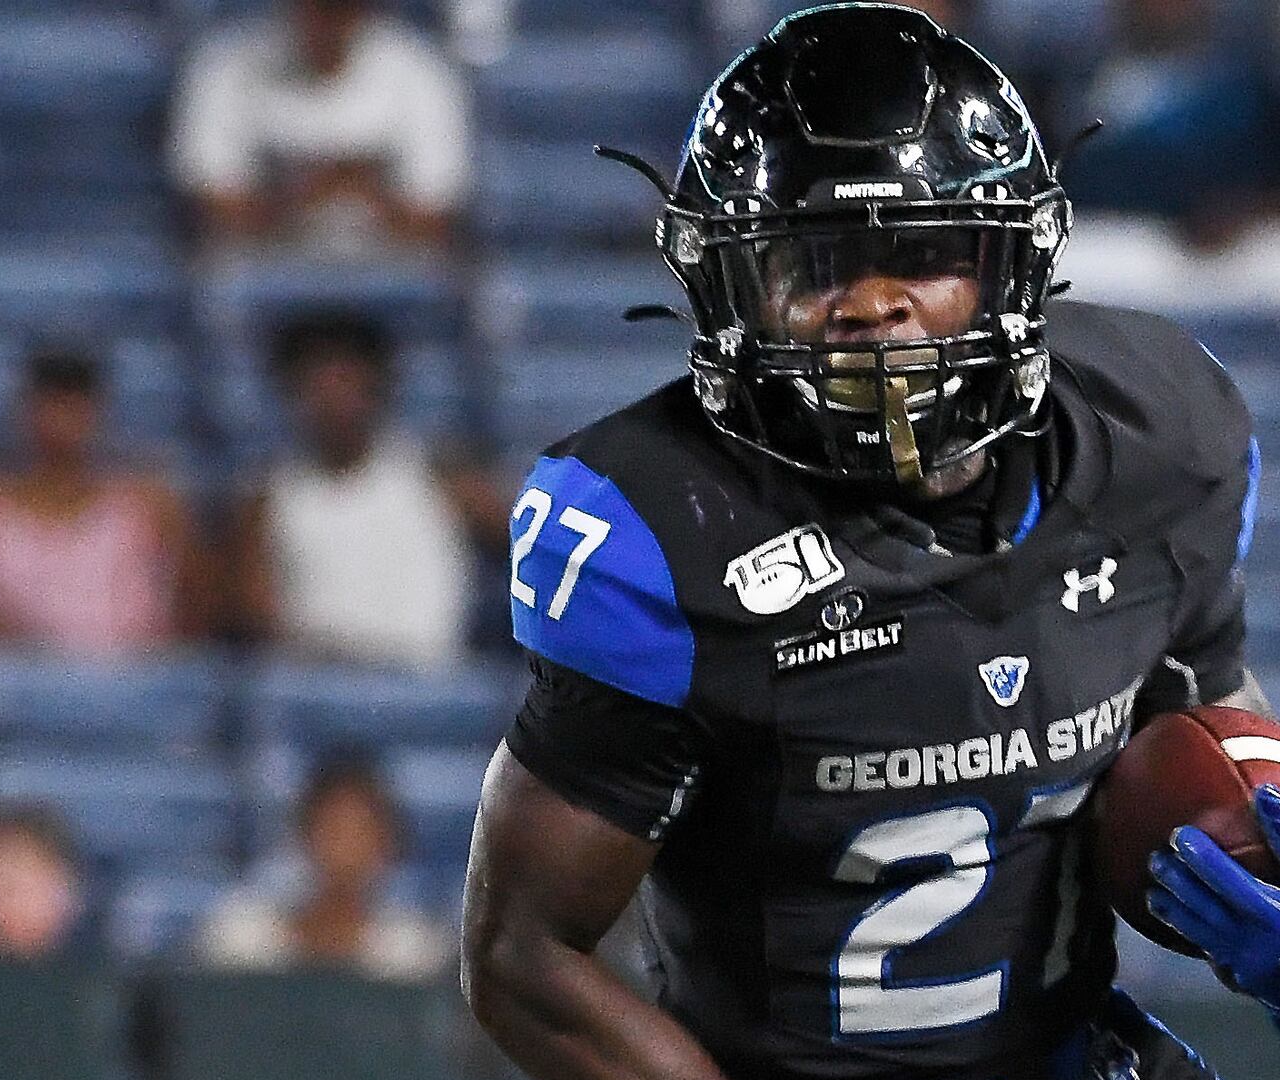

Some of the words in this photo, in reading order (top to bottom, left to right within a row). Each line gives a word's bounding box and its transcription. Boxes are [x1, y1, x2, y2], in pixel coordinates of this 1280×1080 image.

[511, 487, 612, 621] 27
[776, 639, 836, 670] SUN
[840, 622, 902, 655] BELT
[815, 727, 1038, 792] GEORGIA
